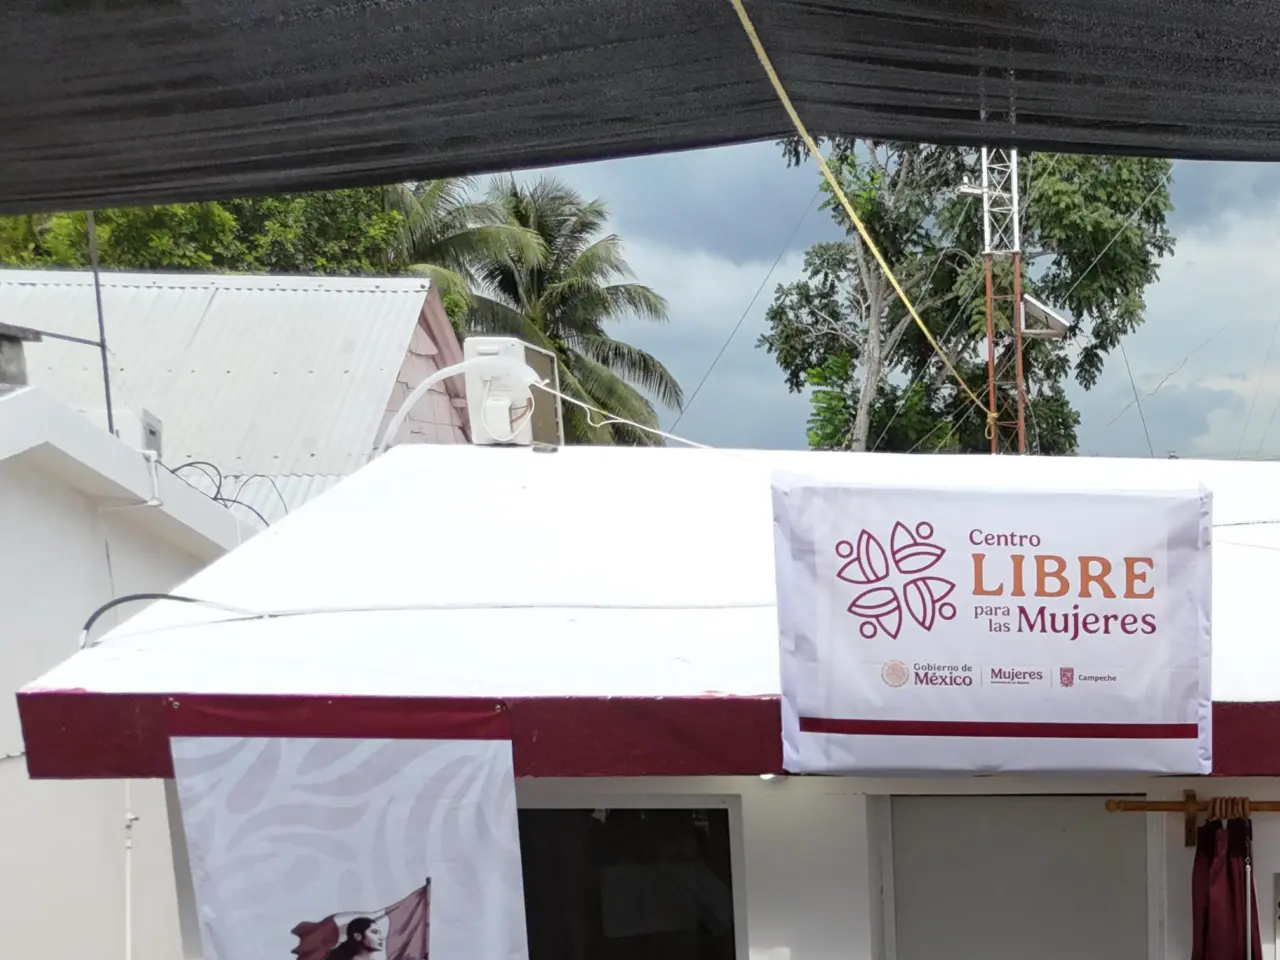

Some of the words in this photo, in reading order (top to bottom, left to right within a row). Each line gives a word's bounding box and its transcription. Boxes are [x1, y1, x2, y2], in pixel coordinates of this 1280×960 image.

[969, 529, 1041, 547] Centro
[971, 553, 1156, 599] LIBRE
[974, 604, 1011, 619] para
[988, 618, 1011, 633] las
[1017, 604, 1157, 641] Mujeres
[914, 663, 959, 672] Gobierno
[961, 663, 973, 672] de
[990, 667, 1043, 682] Mujeres
[914, 671, 973, 686] México
[1078, 674, 1117, 682] Campeche
